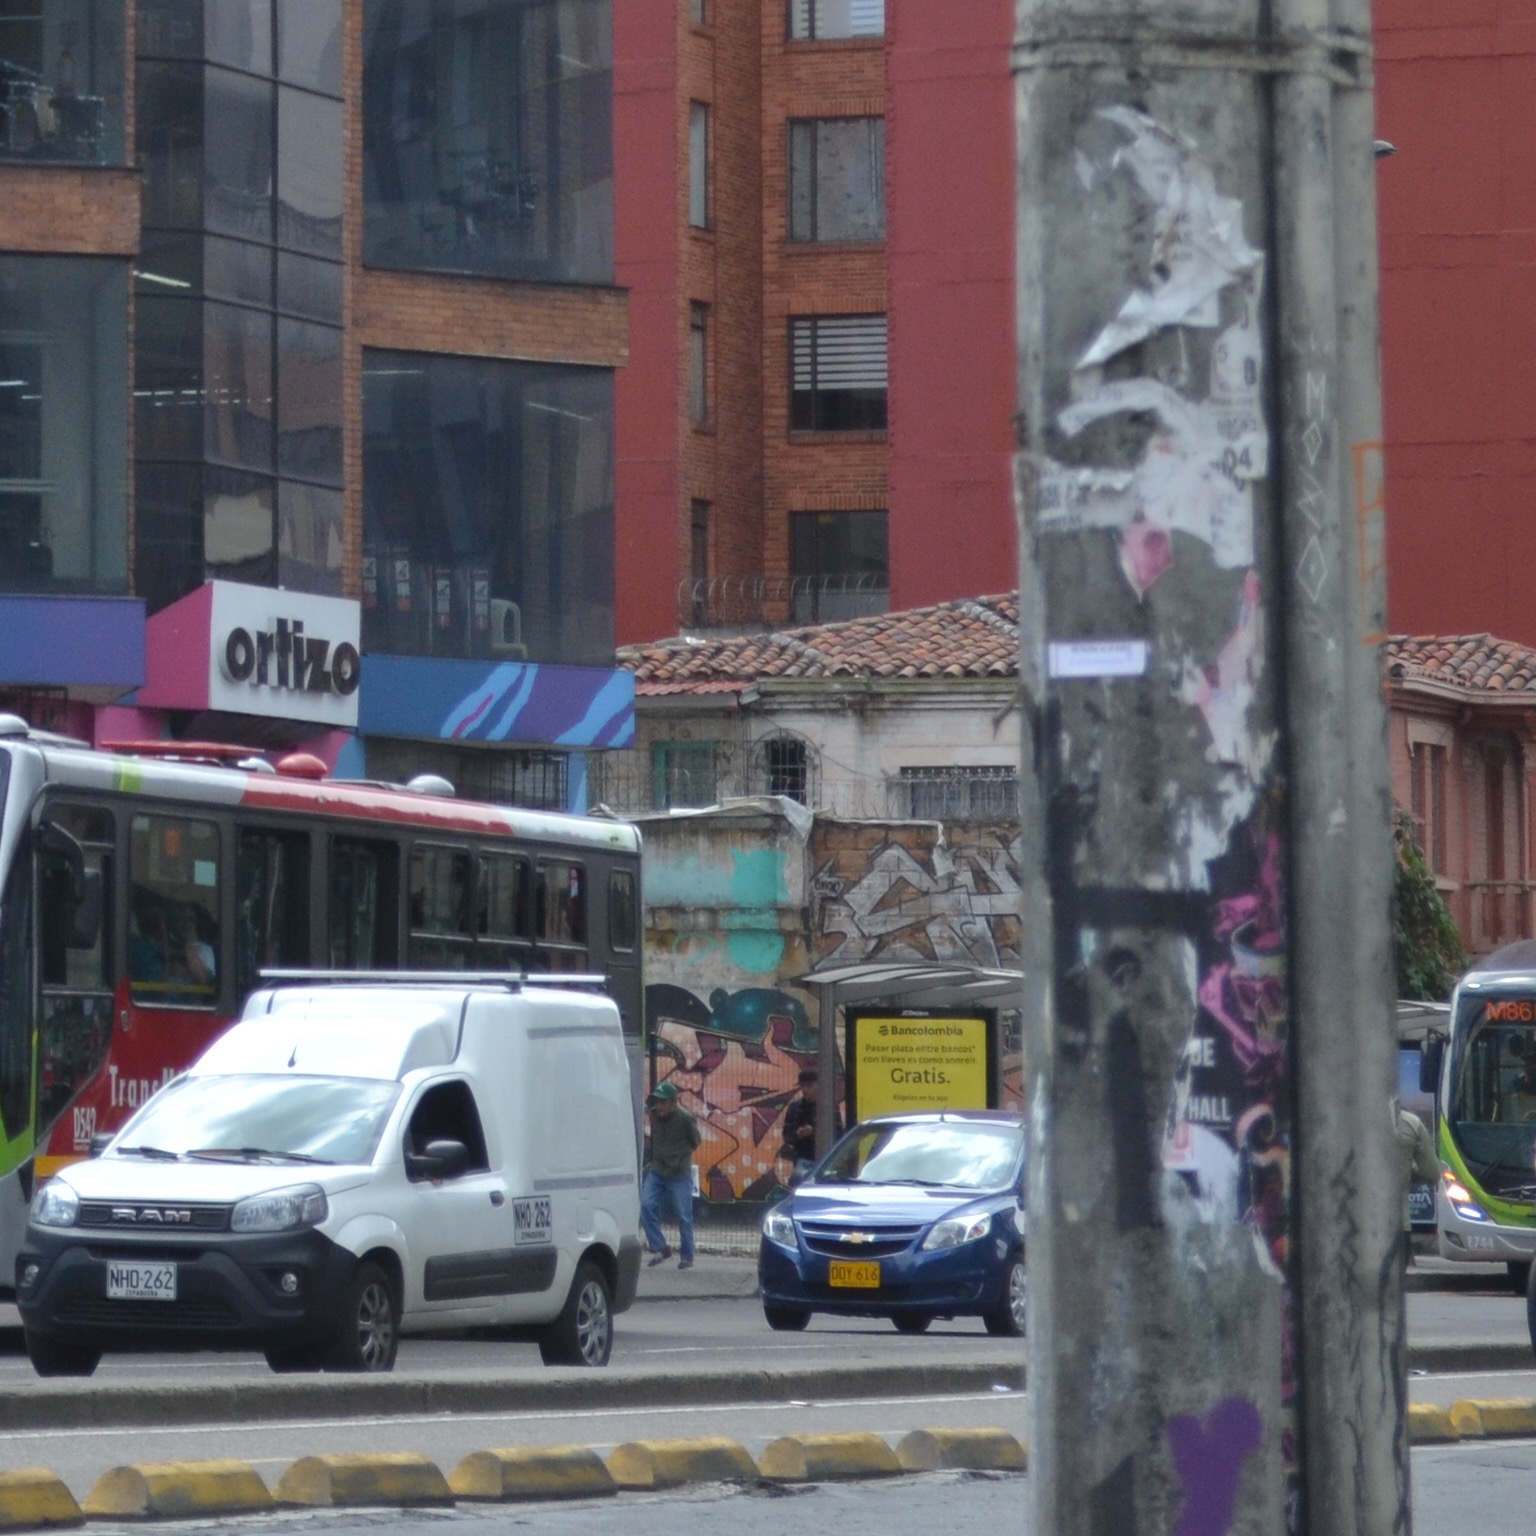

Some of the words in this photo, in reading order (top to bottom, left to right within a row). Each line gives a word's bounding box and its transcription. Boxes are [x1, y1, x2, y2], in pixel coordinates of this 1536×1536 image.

[224, 617, 361, 696] ortizo
[891, 1025, 963, 1037] Bancolombia
[865, 1044, 889, 1054] Pasar
[891, 1044, 914, 1056] plata
[916, 1045, 939, 1054] entre
[863, 1057, 879, 1065] con
[919, 1057, 943, 1065] como
[891, 1068, 951, 1085] Gratis.
[112, 1208, 192, 1223] RAM
